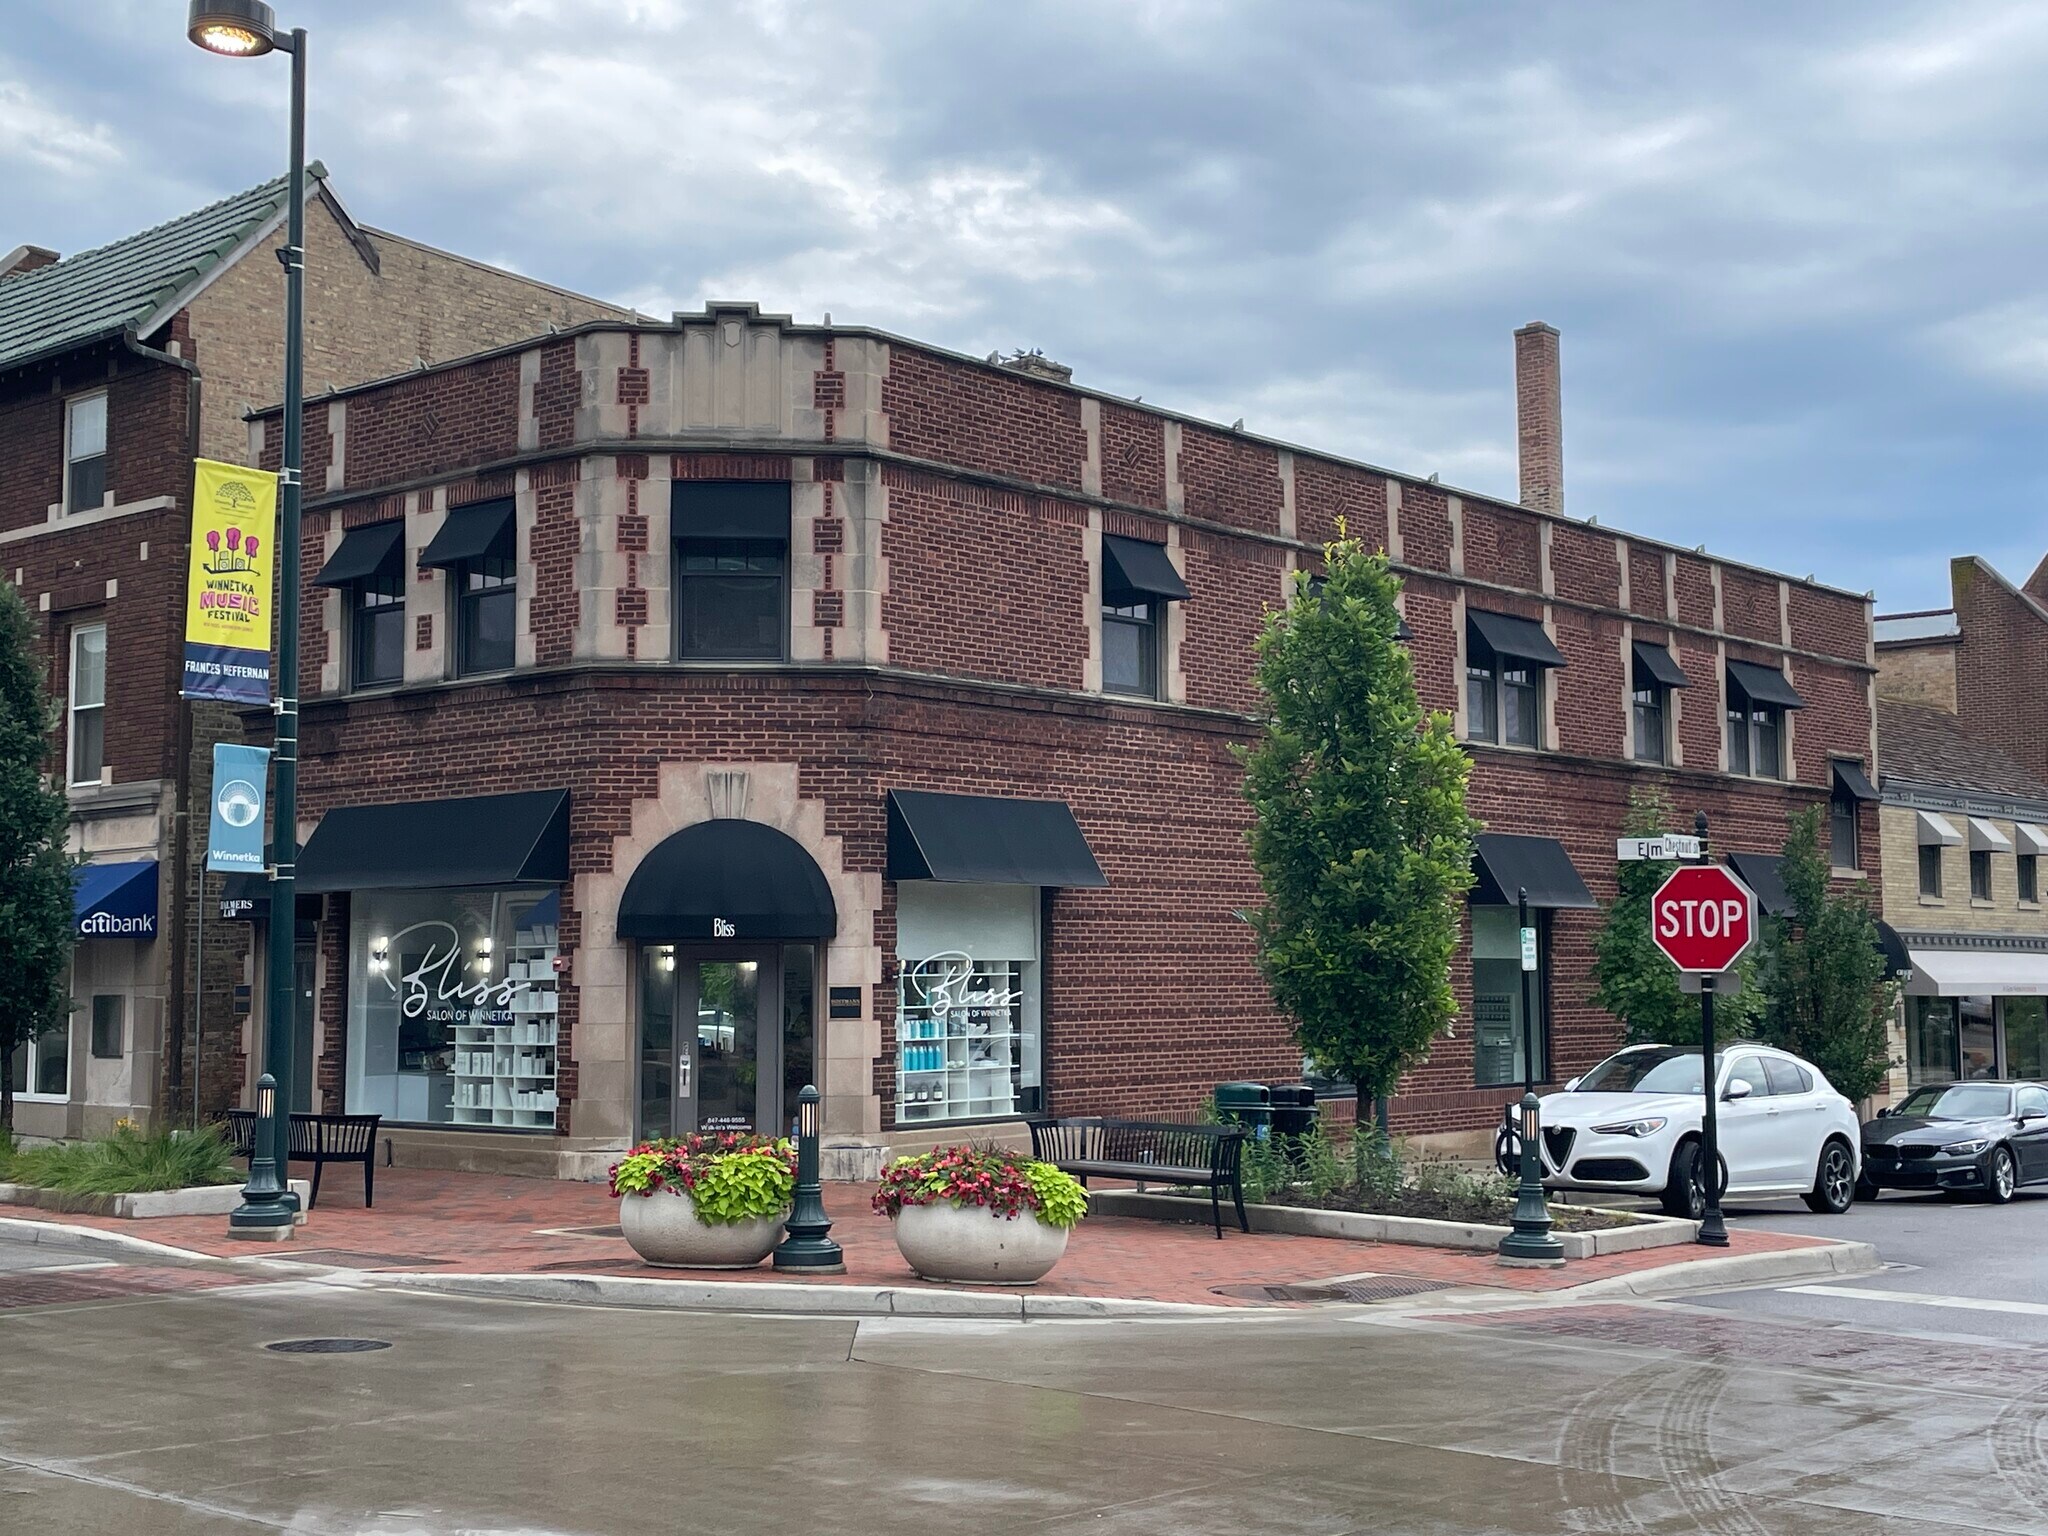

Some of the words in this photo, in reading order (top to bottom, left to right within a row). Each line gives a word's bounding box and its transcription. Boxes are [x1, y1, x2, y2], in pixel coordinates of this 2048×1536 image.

[206, 579, 254, 595] WINNETKA
[200, 591, 259, 617] MUSIC
[207, 610, 250, 622] FESTIVAL
[185, 660, 220, 675] FRANCES
[223, 664, 269, 680] HEFFERNAN
[1638, 842, 1662, 857] Elm
[1665, 837, 1691, 854] Chestnut
[212, 850, 260, 862] Winnetka
[80, 911, 155, 933] citibank
[713, 918, 735, 937] Bliss
[1660, 900, 1743, 938] STOP
[379, 920, 532, 1018] Bliss
[912, 950, 1024, 1016] Bliss
[427, 1010, 454, 1021] SALON
[455, 1010, 467, 1021] OF
[468, 1009, 514, 1021] WINNETKA
[971, 1009, 980, 1018] OF
